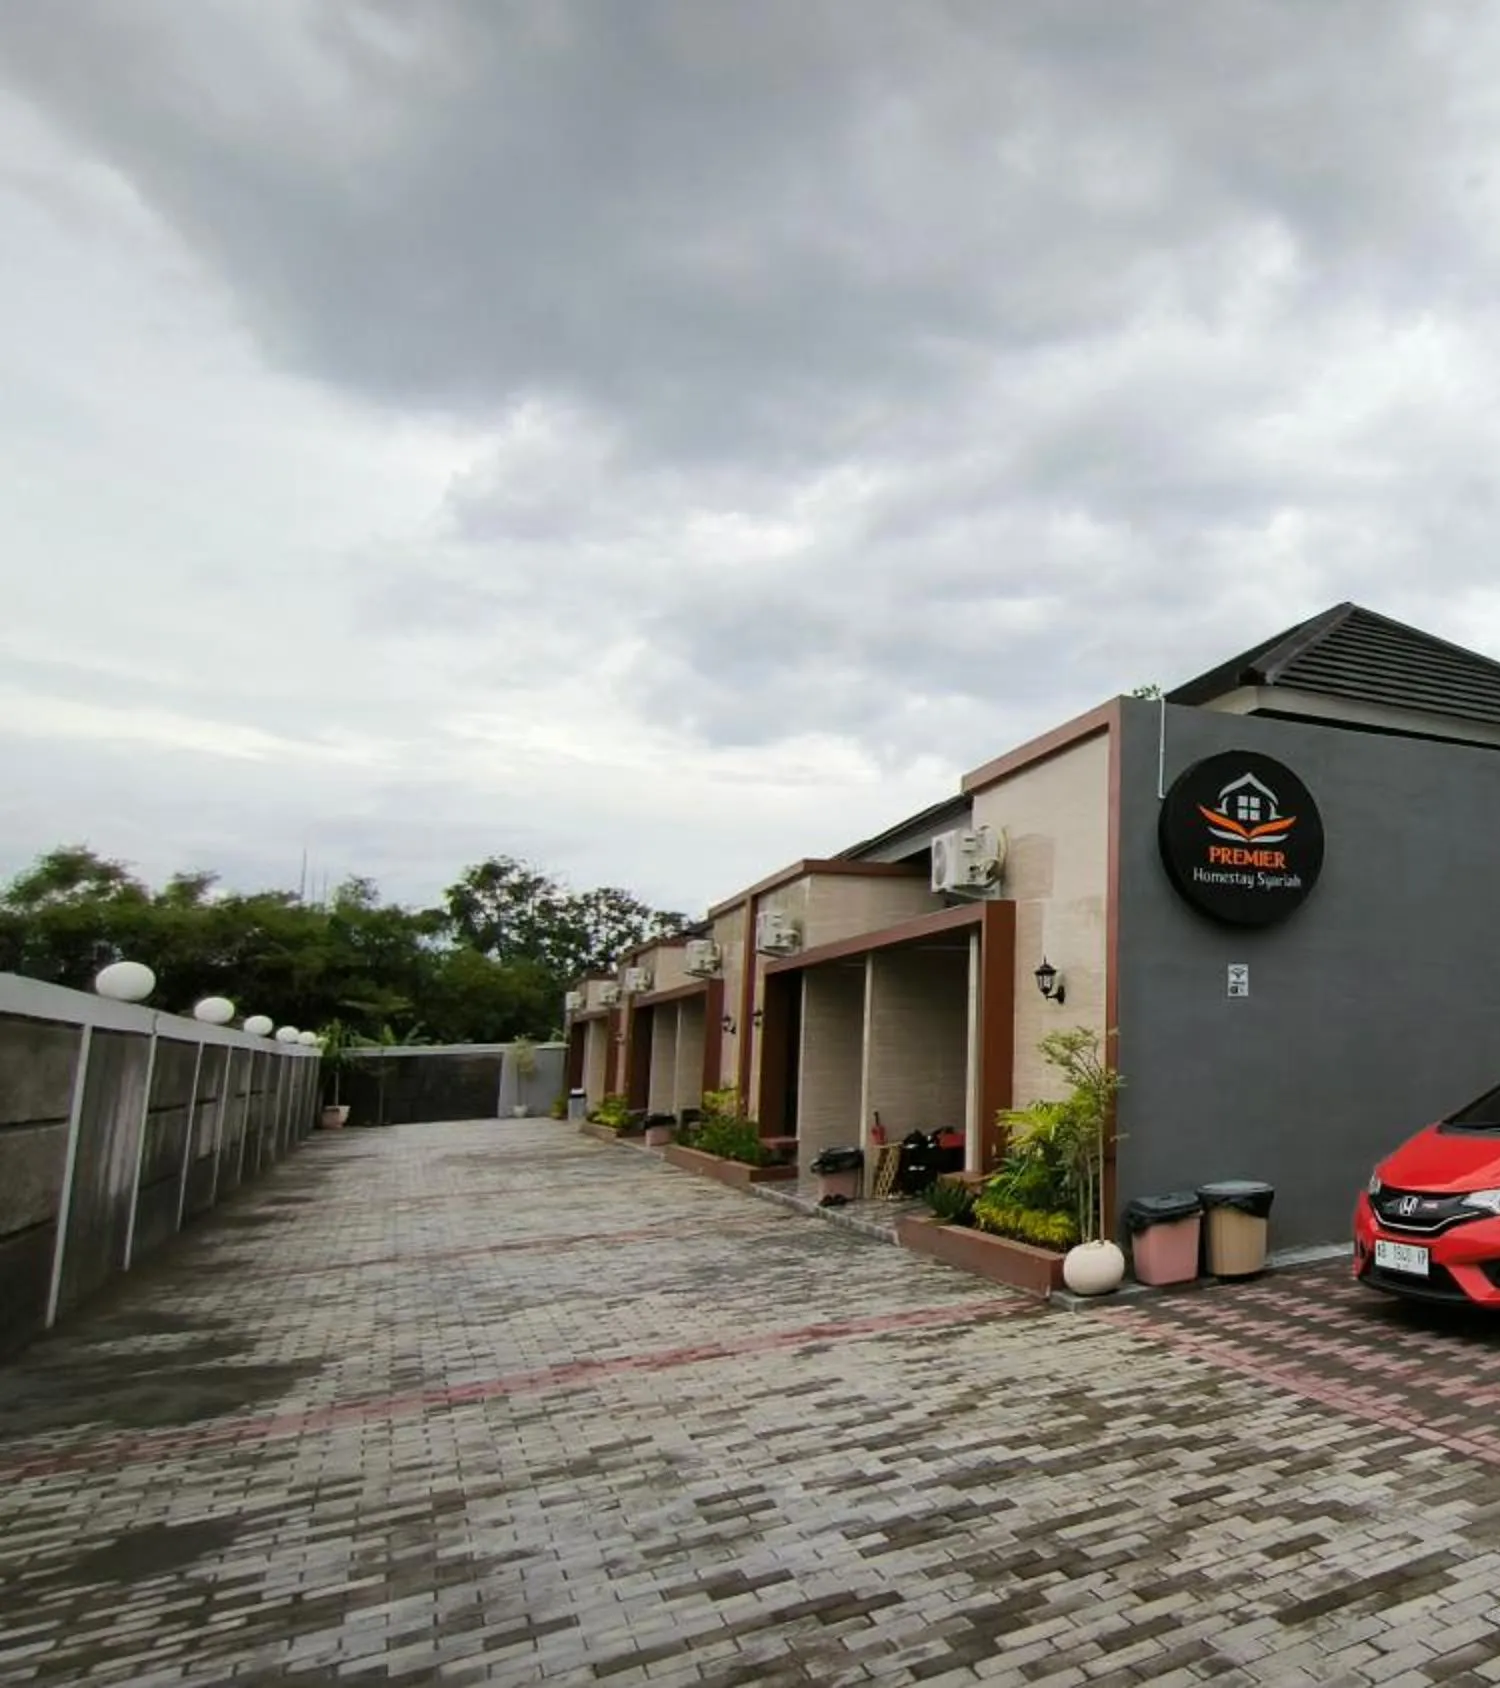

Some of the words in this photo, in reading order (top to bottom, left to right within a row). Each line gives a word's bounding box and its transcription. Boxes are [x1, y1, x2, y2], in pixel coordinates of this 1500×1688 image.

[1208, 846, 1287, 869] PREMIER
[1193, 867, 1255, 889] Homestay
[1257, 872, 1302, 891] Syariah
